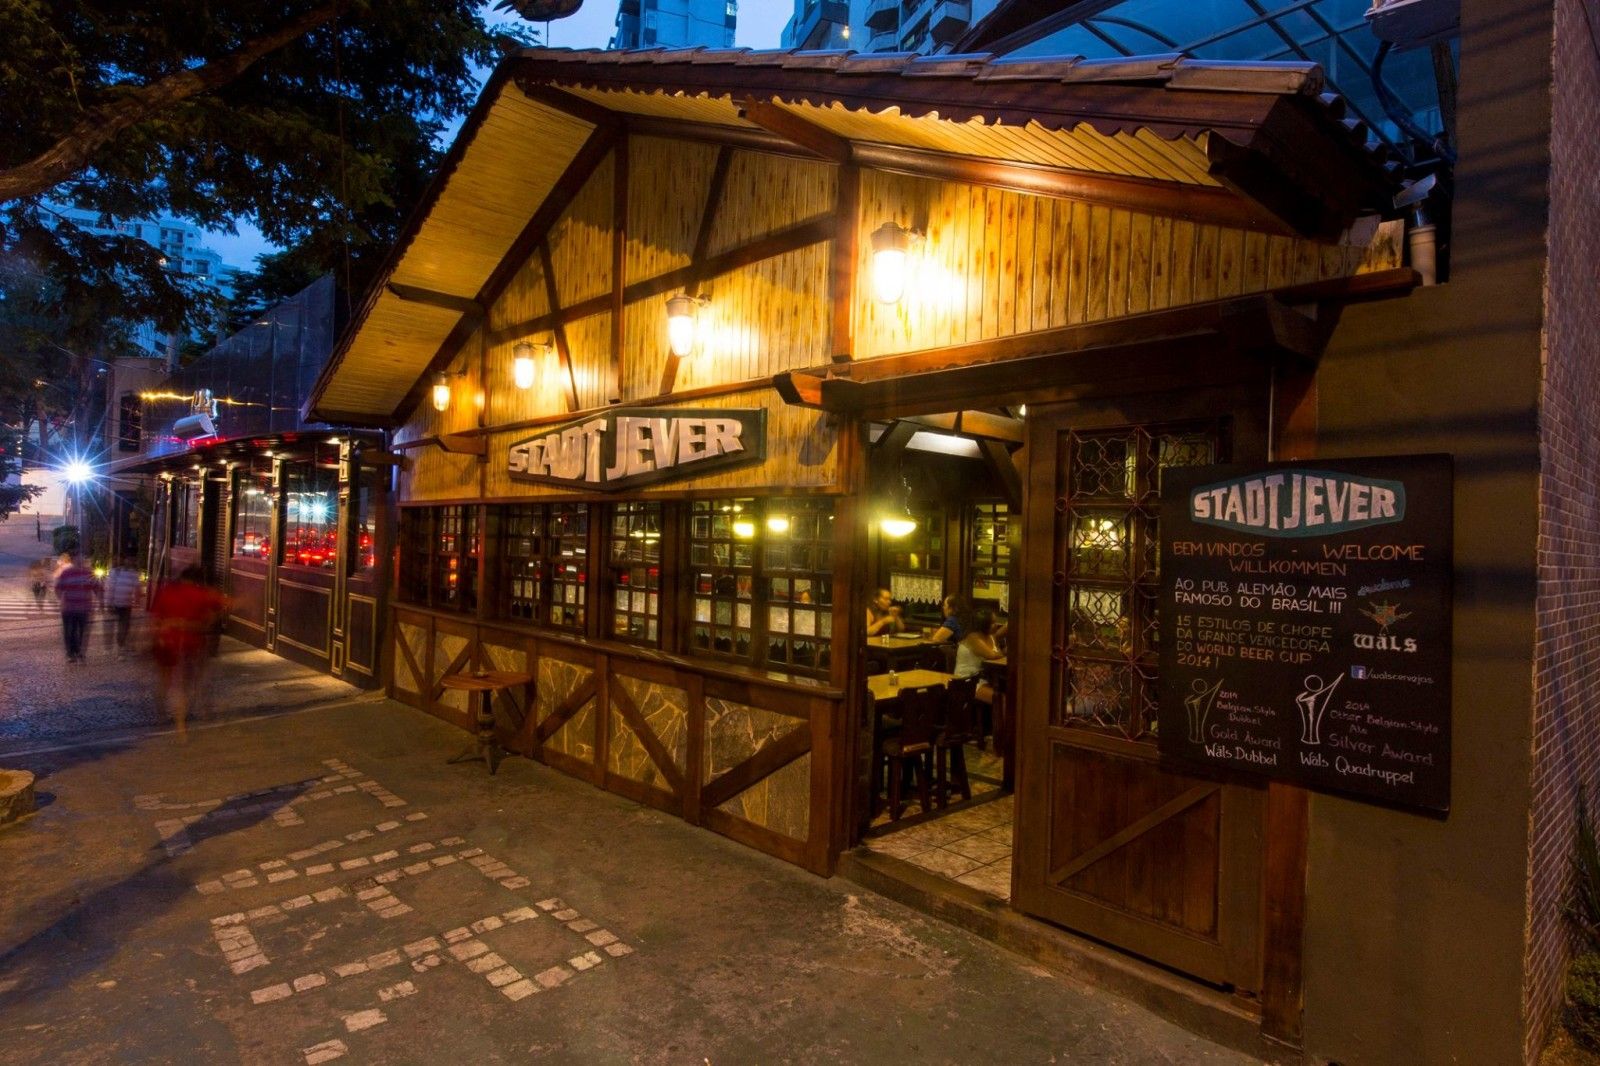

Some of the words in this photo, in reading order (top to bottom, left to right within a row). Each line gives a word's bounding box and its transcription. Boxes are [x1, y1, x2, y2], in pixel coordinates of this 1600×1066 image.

[508, 419, 608, 483] STADT
[605, 416, 745, 481] JEVER
[1194, 474, 1284, 530] STADT
[1283, 473, 1396, 529] JEVER
[1173, 542, 1203, 556] BEM
[1206, 542, 1265, 557] VINDOS
[1323, 544, 1425, 561] WELCOME
[1229, 559, 1347, 576] WILLKOMMEN
[1175, 577, 1194, 591] AO
[1202, 580, 1229, 593] PUB
[1237, 582, 1296, 596] ALEMÃO
[1307, 586, 1347, 599] MAIS
[1175, 592, 1232, 606] FAMOSO
[1240, 597, 1260, 609] DO
[1271, 599, 1323, 613] BRASIL
[1177, 615, 1191, 626] 15
[1198, 617, 1251, 631] ESTILOS
[1257, 621, 1276, 633] DE
[1281, 623, 1333, 638] CHOPE
[1177, 628, 1193, 639] DA
[1198, 629, 1244, 645] GRANDE
[1249, 633, 1331, 652] VENCEDORA
[1177, 640, 1192, 652] DO
[1196, 642, 1235, 657] WORLD
[1240, 646, 1274, 661] BEER
[1279, 651, 1312, 664] CUP
[1177, 653, 1211, 667] 2014
[1229, 713, 1262, 726] Dubbel
[1210, 723, 1238, 740] Gold
[1245, 731, 1281, 749] Award
[1235, 746, 1277, 766] Dubbel
[1328, 733, 1376, 754] Silver
[1381, 743, 1434, 766] Award
[1335, 755, 1415, 786] Quadruppel
